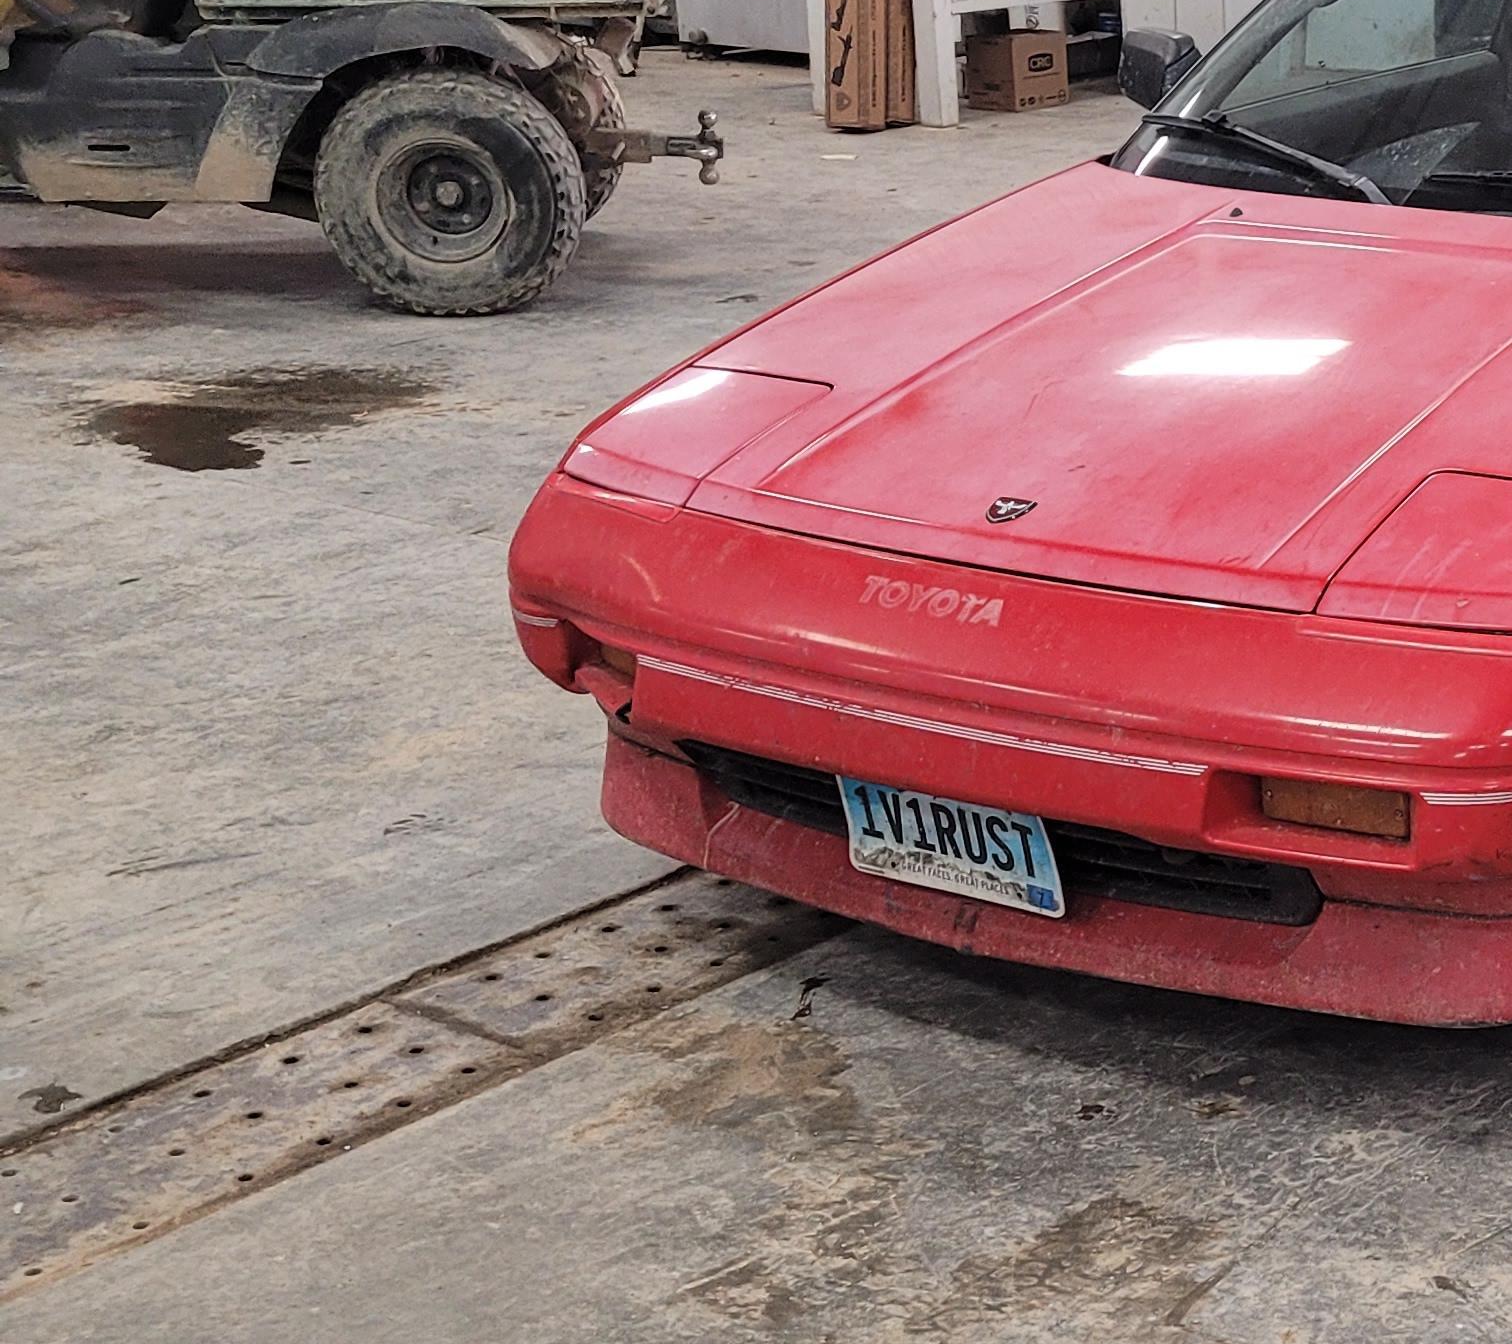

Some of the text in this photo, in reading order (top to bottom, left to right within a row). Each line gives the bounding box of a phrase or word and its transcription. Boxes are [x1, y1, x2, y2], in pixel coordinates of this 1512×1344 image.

[858, 575, 1005, 627] TOYOTA
[853, 785, 1036, 879] 1V1RUST
[901, 861, 927, 876] GREAT
[954, 873, 980, 889] GREAT
